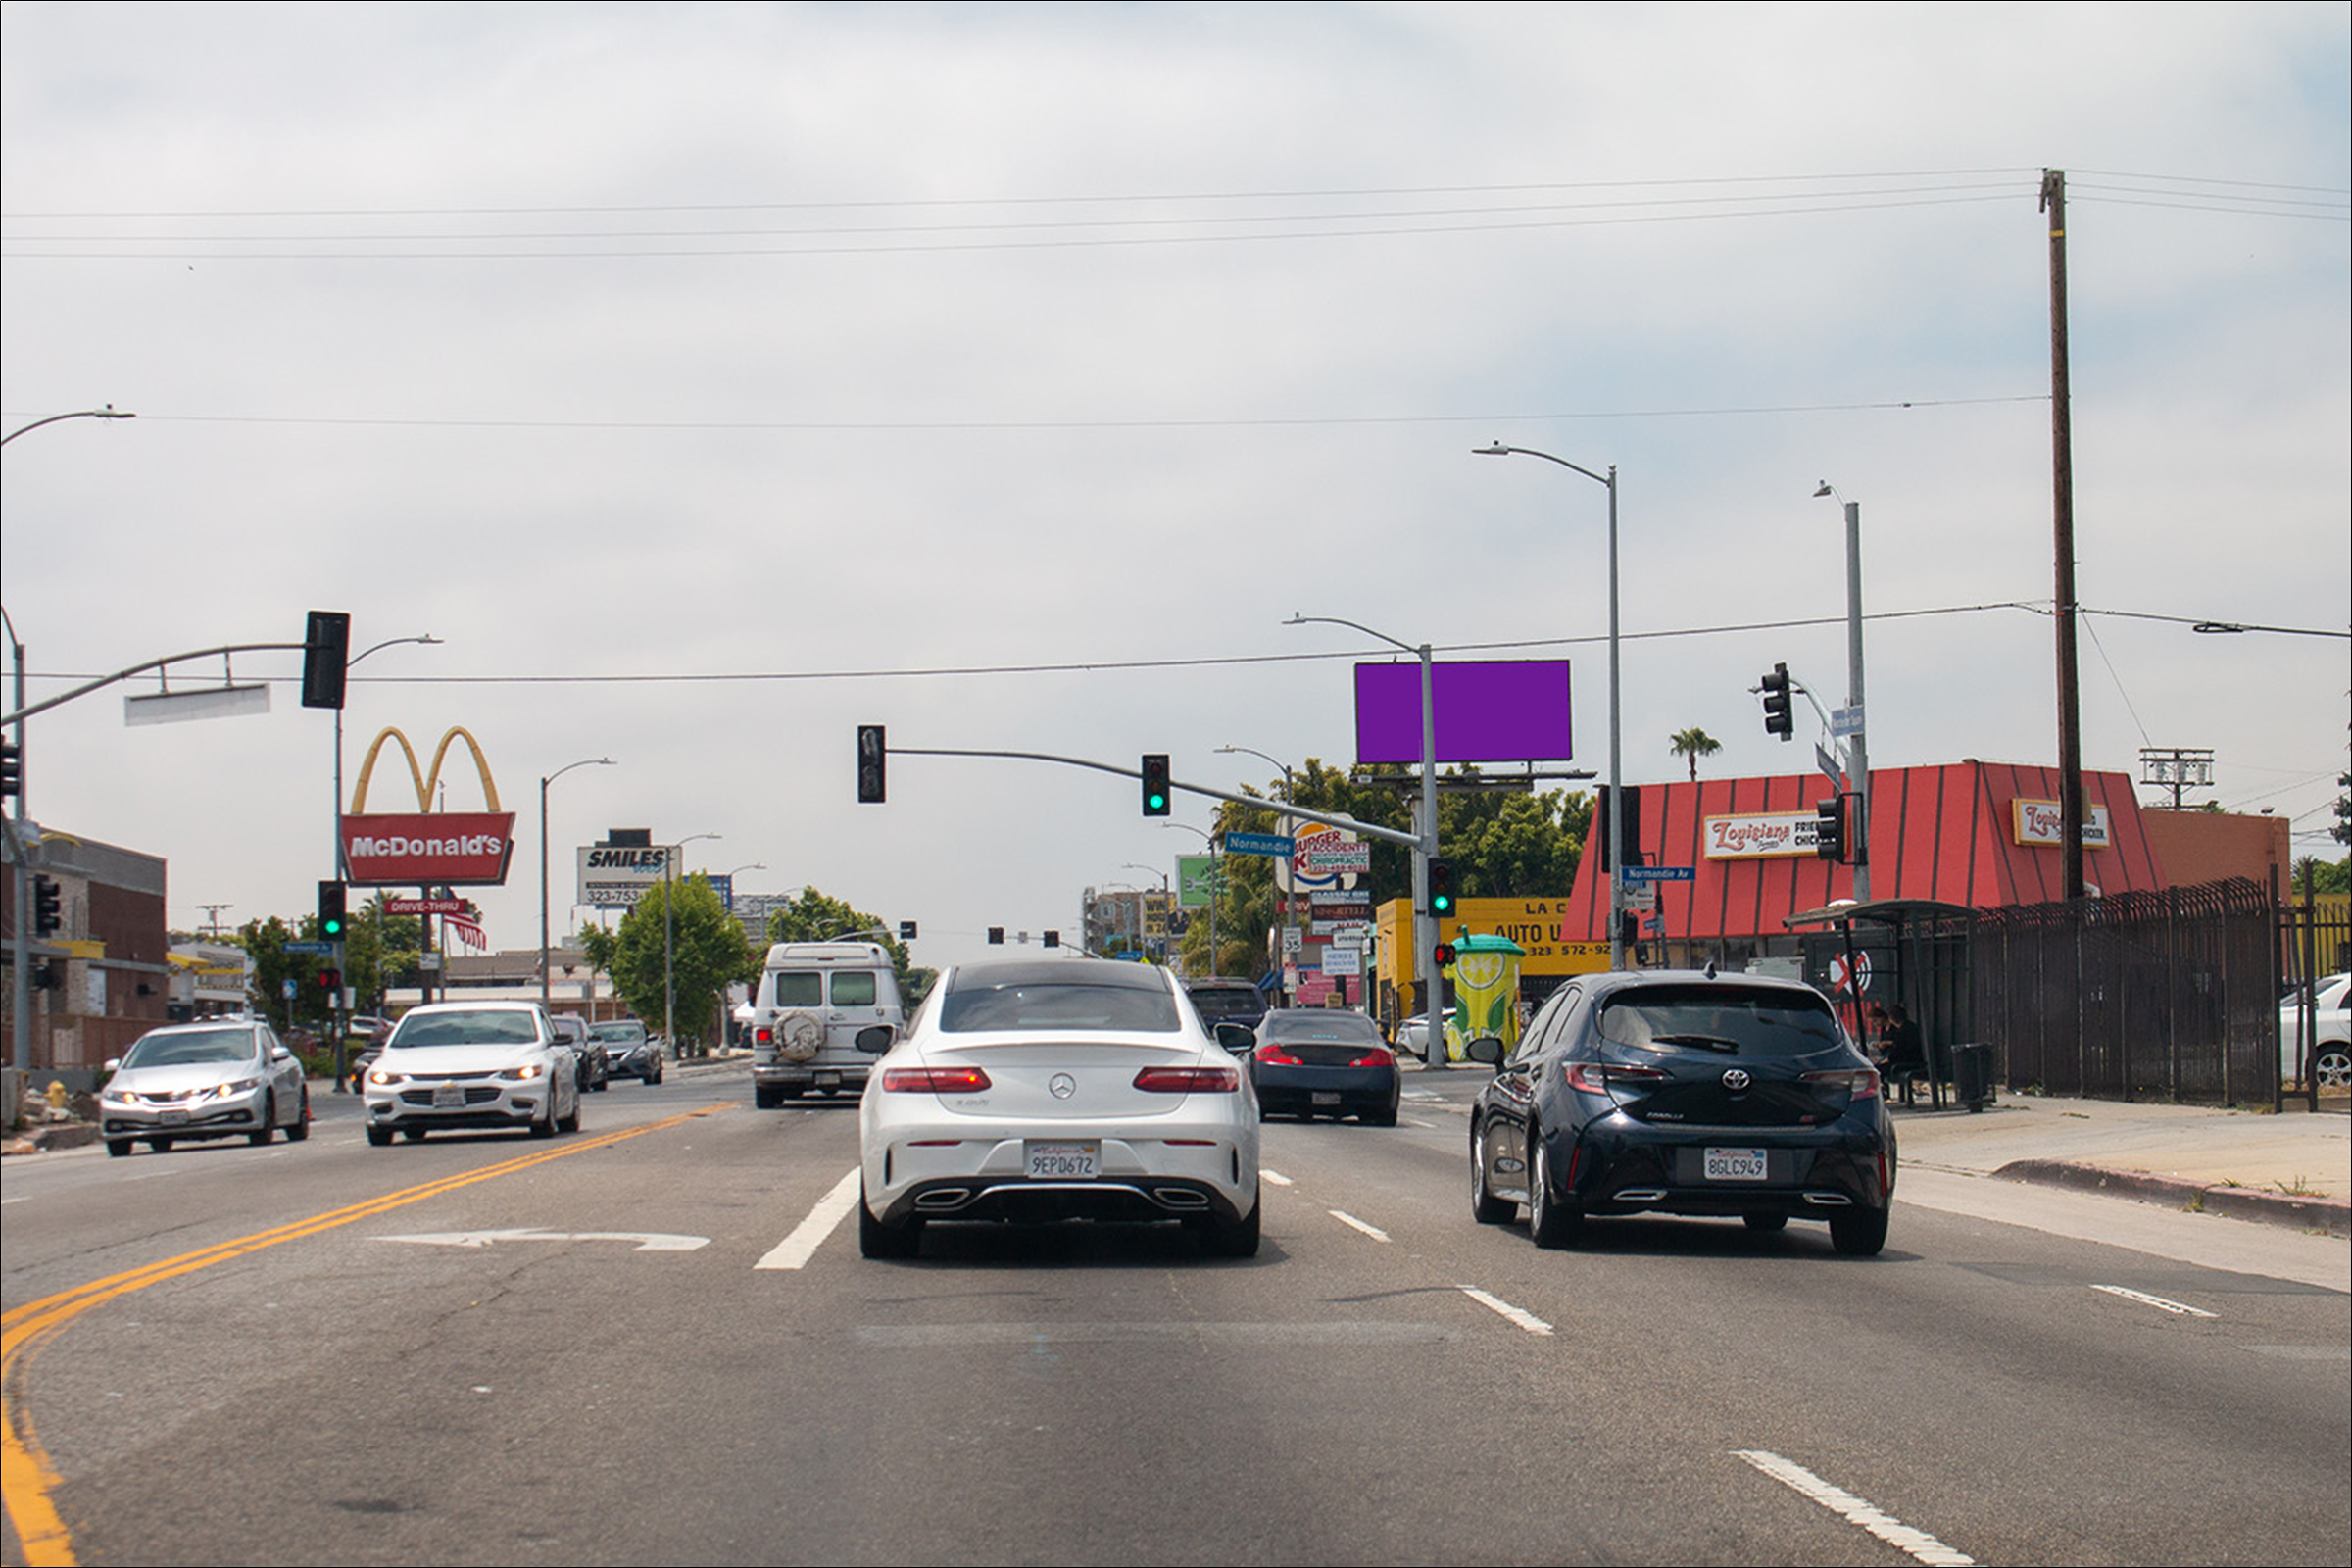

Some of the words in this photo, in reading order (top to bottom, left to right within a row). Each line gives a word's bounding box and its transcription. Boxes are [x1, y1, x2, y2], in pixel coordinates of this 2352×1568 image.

[1795, 821, 1820, 832] FRIE
[1712, 821, 1791, 851] Louisiana
[351, 836, 502, 857] McDonald's
[1230, 837, 1291, 853] Normandie
[1312, 844, 1368, 853] ACCIDENT?
[587, 851, 664, 868] SMILES
[1628, 868, 1676, 879] Normandie
[1677, 868, 1690, 878] Av
[391, 899, 460, 912] DRIVE-THRU
[1526, 903, 1548, 914] LA
[1494, 924, 1543, 943] AUTO
[1285, 940, 1301, 951] 35
[1530, 946, 1553, 956] 323
[1032, 1156, 1094, 1174] 9EPD672
[1708, 1158, 1763, 1176] 8GLC949
